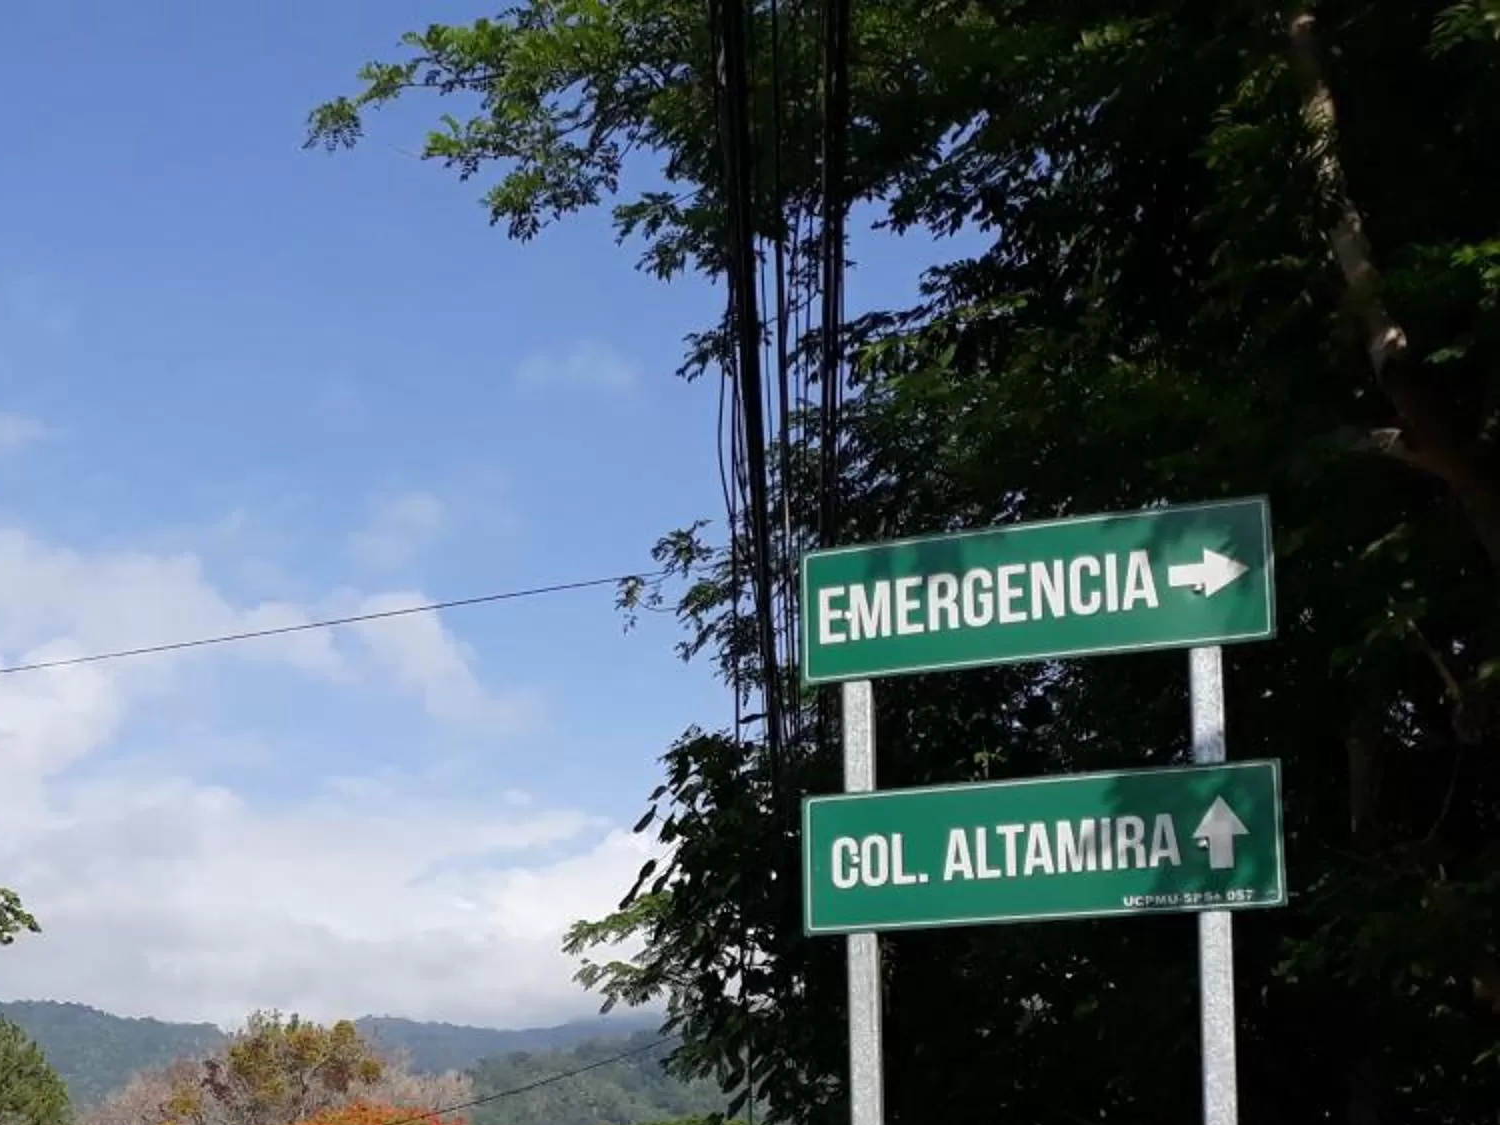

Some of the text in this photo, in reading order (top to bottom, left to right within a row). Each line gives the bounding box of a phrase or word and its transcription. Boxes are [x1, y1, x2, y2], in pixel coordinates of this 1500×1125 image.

[818, 550, 1159, 645] EMERGENCIA
[831, 813, 1181, 889] COL. ALTAMIRA
